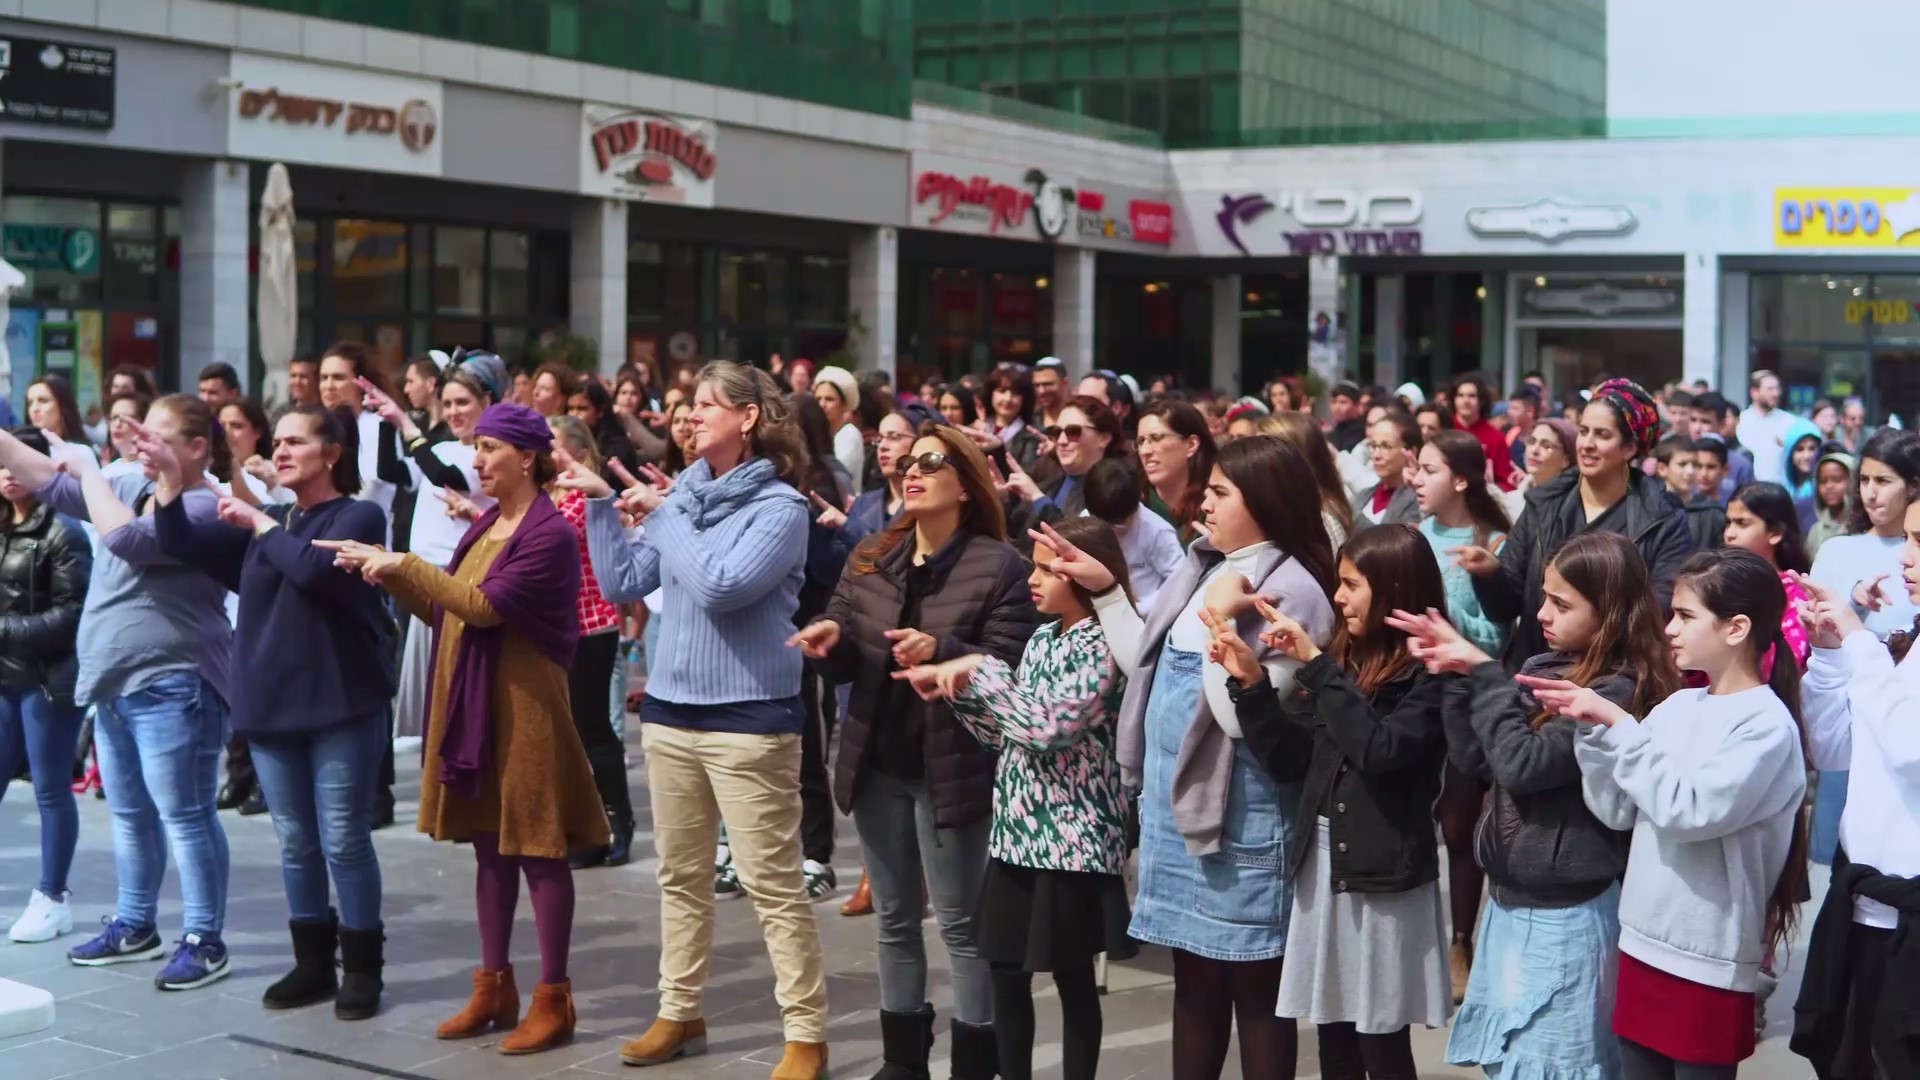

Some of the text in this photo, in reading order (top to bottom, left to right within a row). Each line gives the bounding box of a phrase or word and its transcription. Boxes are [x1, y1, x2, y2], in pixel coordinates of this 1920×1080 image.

[239, 86, 396, 135] בנק ירושלים
[1781, 200, 1881, 235] ספרים
[1845, 301, 1909, 325] ספרים
